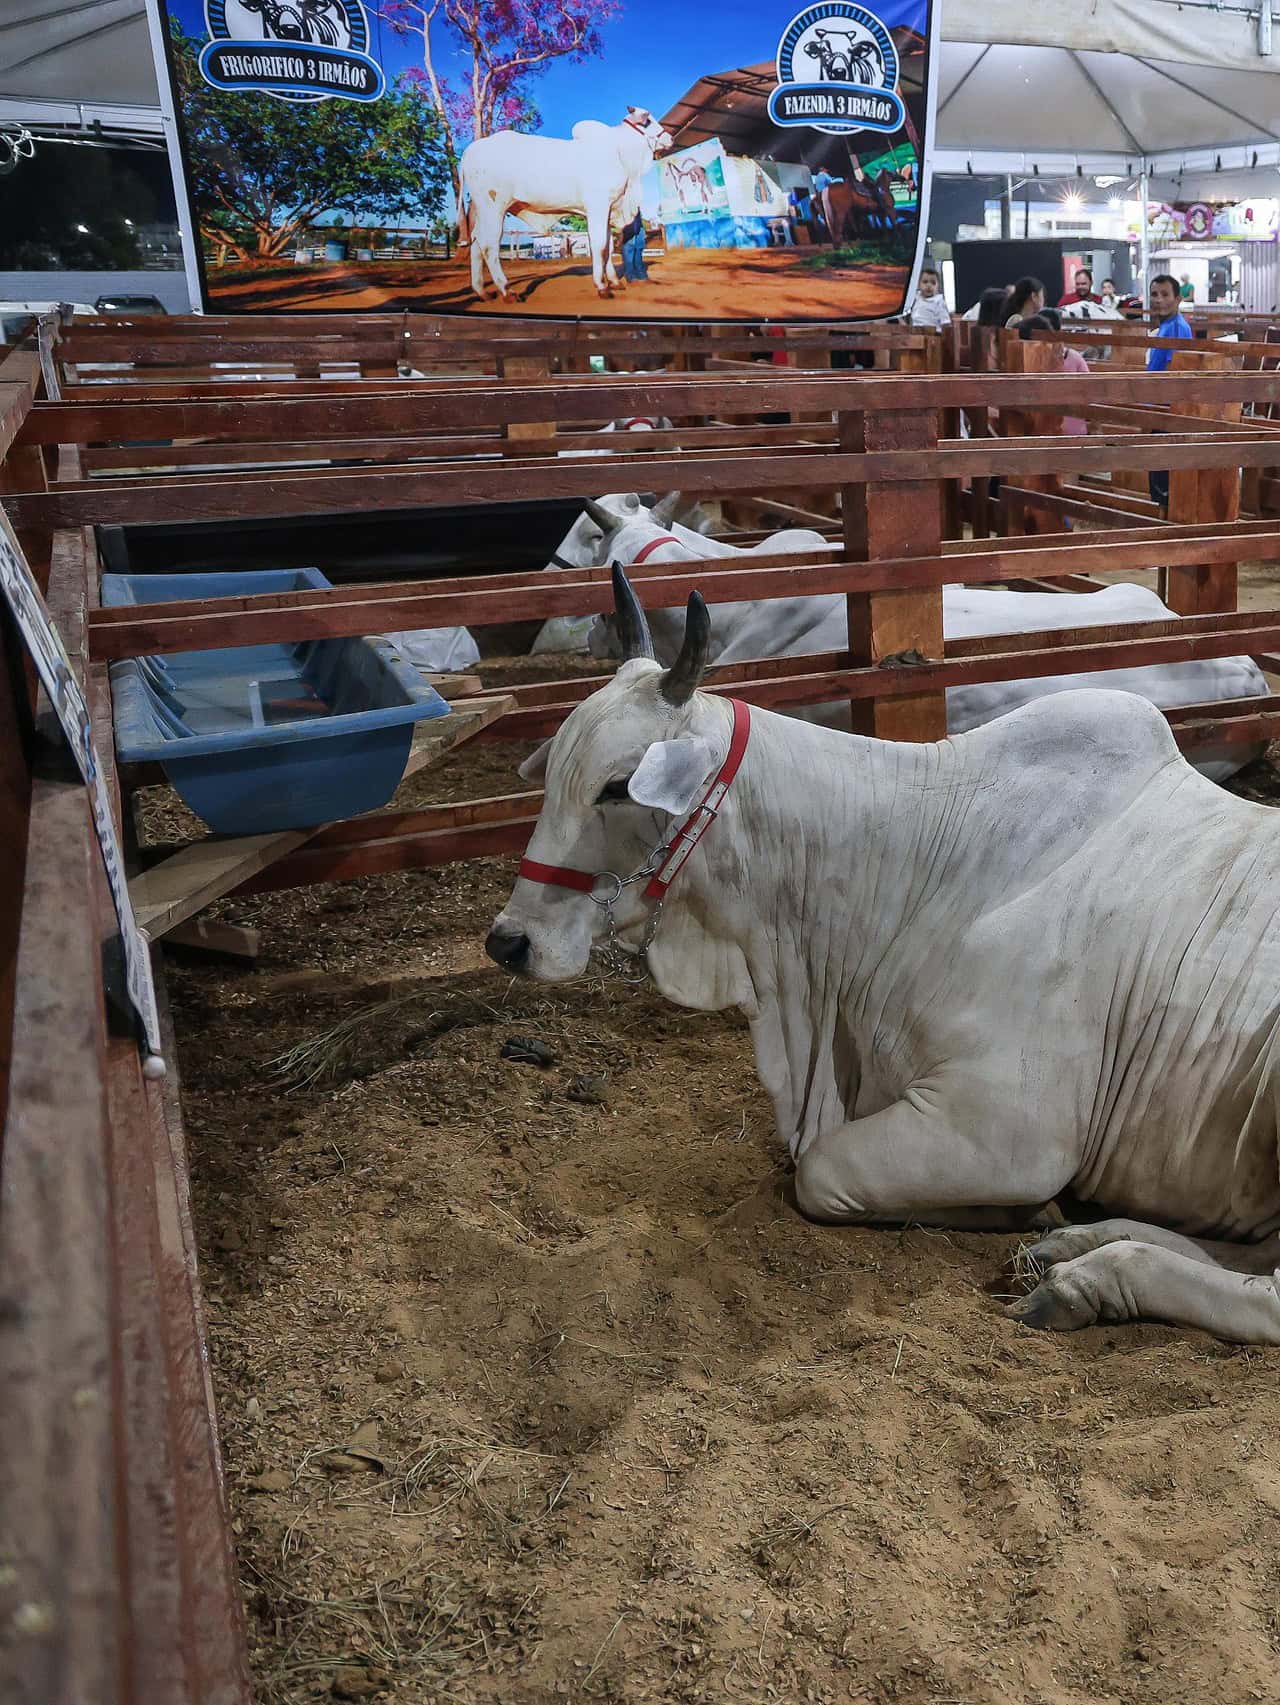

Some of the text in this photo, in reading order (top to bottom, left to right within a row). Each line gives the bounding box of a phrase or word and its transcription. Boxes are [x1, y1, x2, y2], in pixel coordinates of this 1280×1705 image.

[219, 55, 367, 89] FRIGORIFICO 3 IRMÃOS
[784, 95, 892, 121] FAZENDA 3 IRMÃOS
